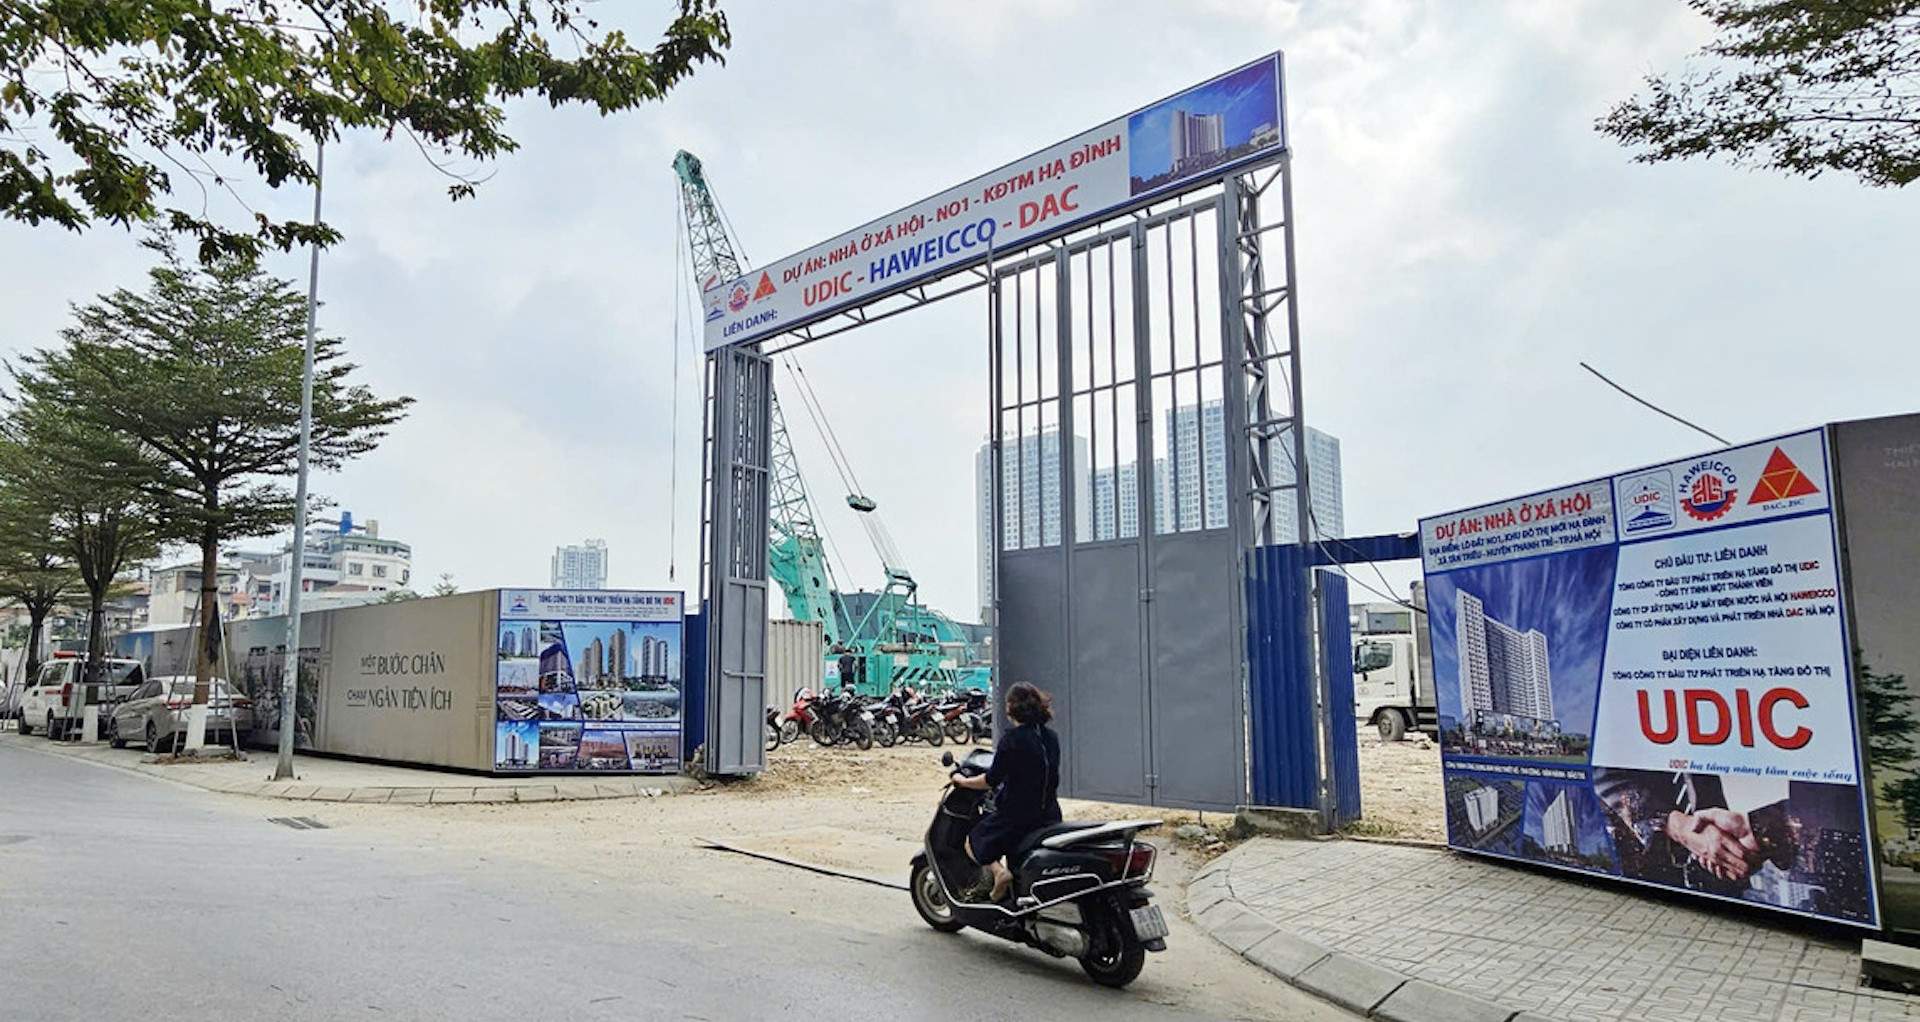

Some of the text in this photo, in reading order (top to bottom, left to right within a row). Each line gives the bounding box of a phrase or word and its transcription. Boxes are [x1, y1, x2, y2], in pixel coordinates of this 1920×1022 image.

[783, 262, 802, 283] DỰ
[804, 256, 826, 275] ÁN:
[828, 240, 858, 265] NHÀ
[861, 233, 872, 251] Ở
[874, 225, 894, 247] XÃ
[897, 214, 924, 237] HỘI
[984, 170, 1034, 204] KĐTM
[1038, 161, 1065, 180] HẠ
[1070, 135, 1120, 169] ĐÌNH
[803, 271, 852, 307] UDIC
[870, 217, 996, 284] HAWEICCO
[1019, 184, 1079, 230] DAC
[724, 308, 778, 337] LIÊN DANH:
[1679, 460, 1737, 493] HAWEICCO
[1634, 491, 1660, 504] UDIC
[1436, 493, 1592, 541] DỰ ÁN: NHÀ Ở XÃ HỘI
[1654, 556, 1673, 569] CHỦ
[1675, 554, 1694, 566] ĐẦU
[1714, 548, 1736, 562] LIÊN
[1738, 544, 1768, 559] DANH
[378, 652, 409, 675] BƯỚC
[412, 652, 445, 675] CHÂN
[1662, 649, 1677, 662] ĐẠI
[1680, 648, 1700, 662] DIỆN
[1702, 646, 1724, 658] LIÊN
[402, 686, 427, 713] TIỆN
[430, 686, 452, 710] ÍCH
[1636, 687, 1813, 751] UDIC
[1669, 760, 1688, 768] UDIC
